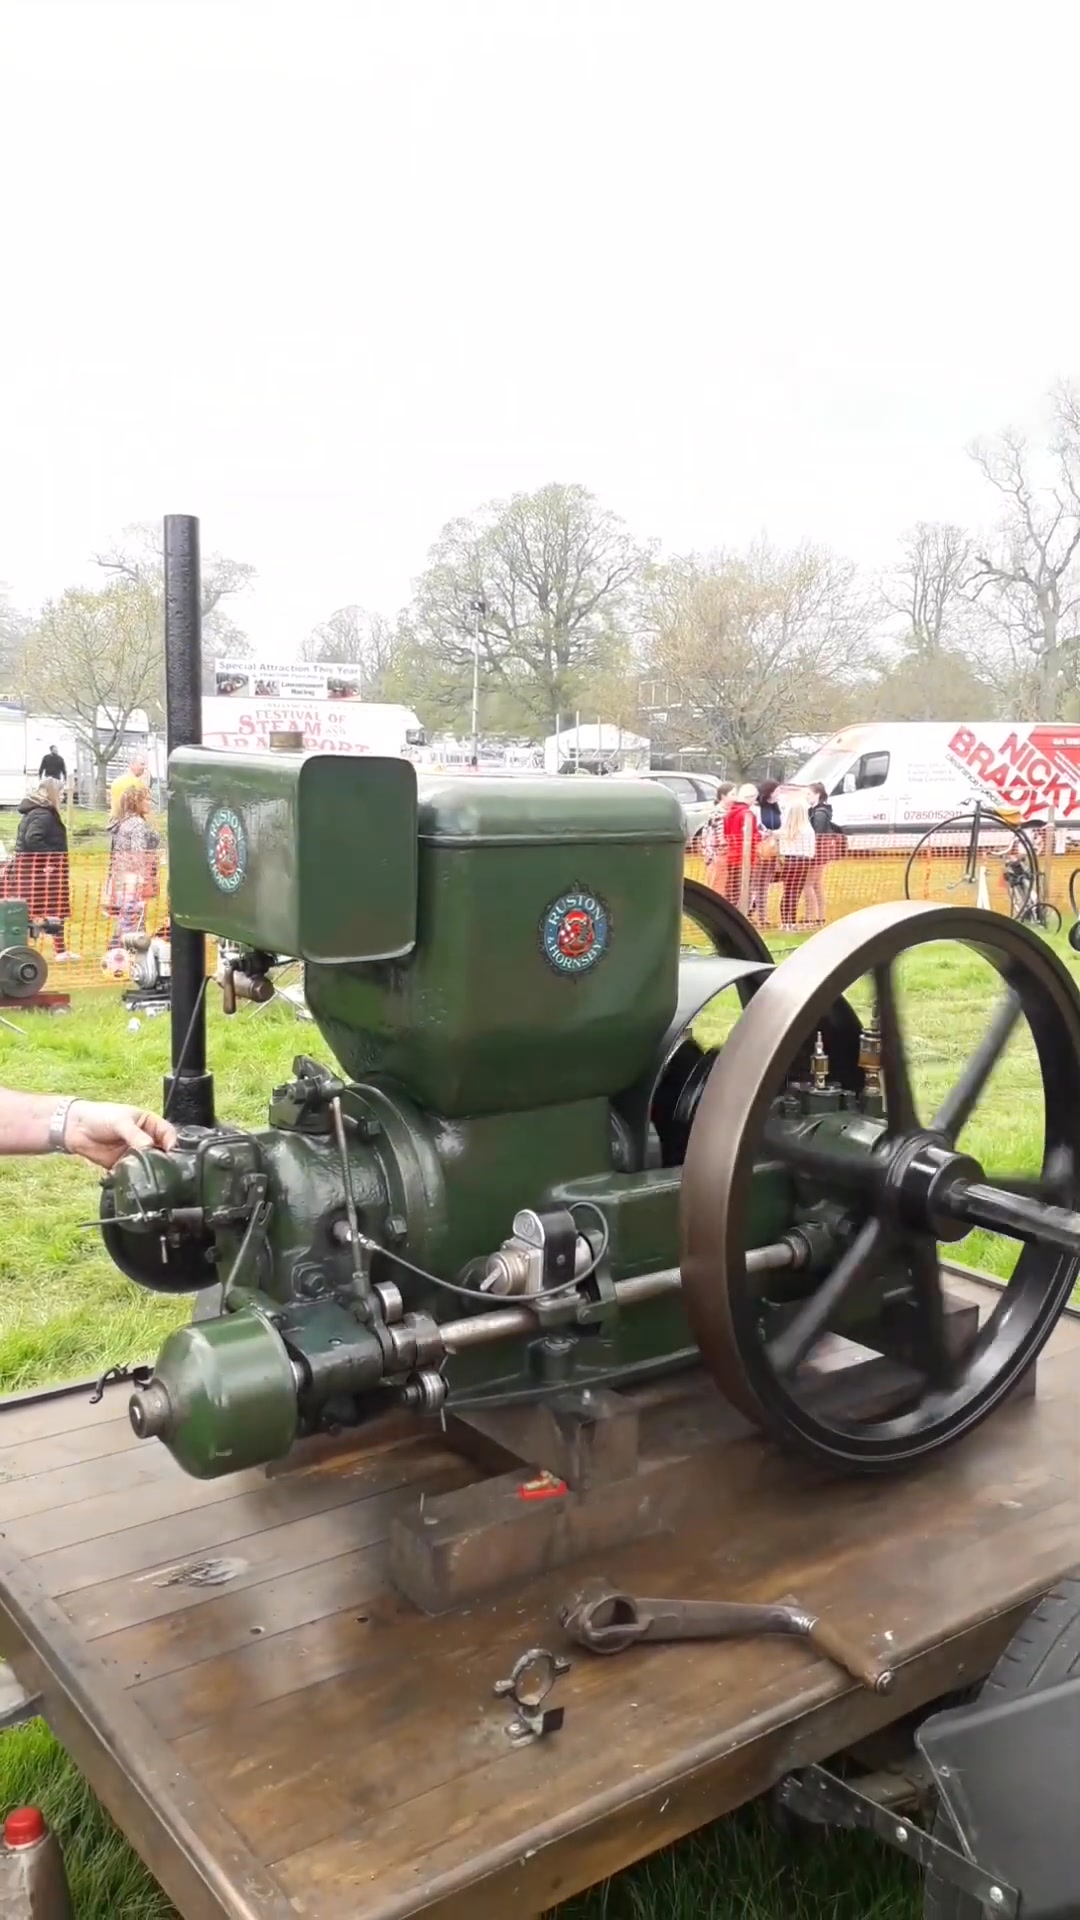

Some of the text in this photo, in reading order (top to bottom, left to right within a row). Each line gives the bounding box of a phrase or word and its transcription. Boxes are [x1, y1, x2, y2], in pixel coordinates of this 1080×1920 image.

[219, 661, 359, 675] Special Attraction This Year
[238, 714, 322, 737] STEAM
[255, 709, 346, 724] FESTIVAL OF
[947, 725, 1050, 820] BRADY
[998, 731, 1080, 817] NICKY
[548, 894, 604, 926] RUSTON
[549, 943, 602, 969] HORNSBY
